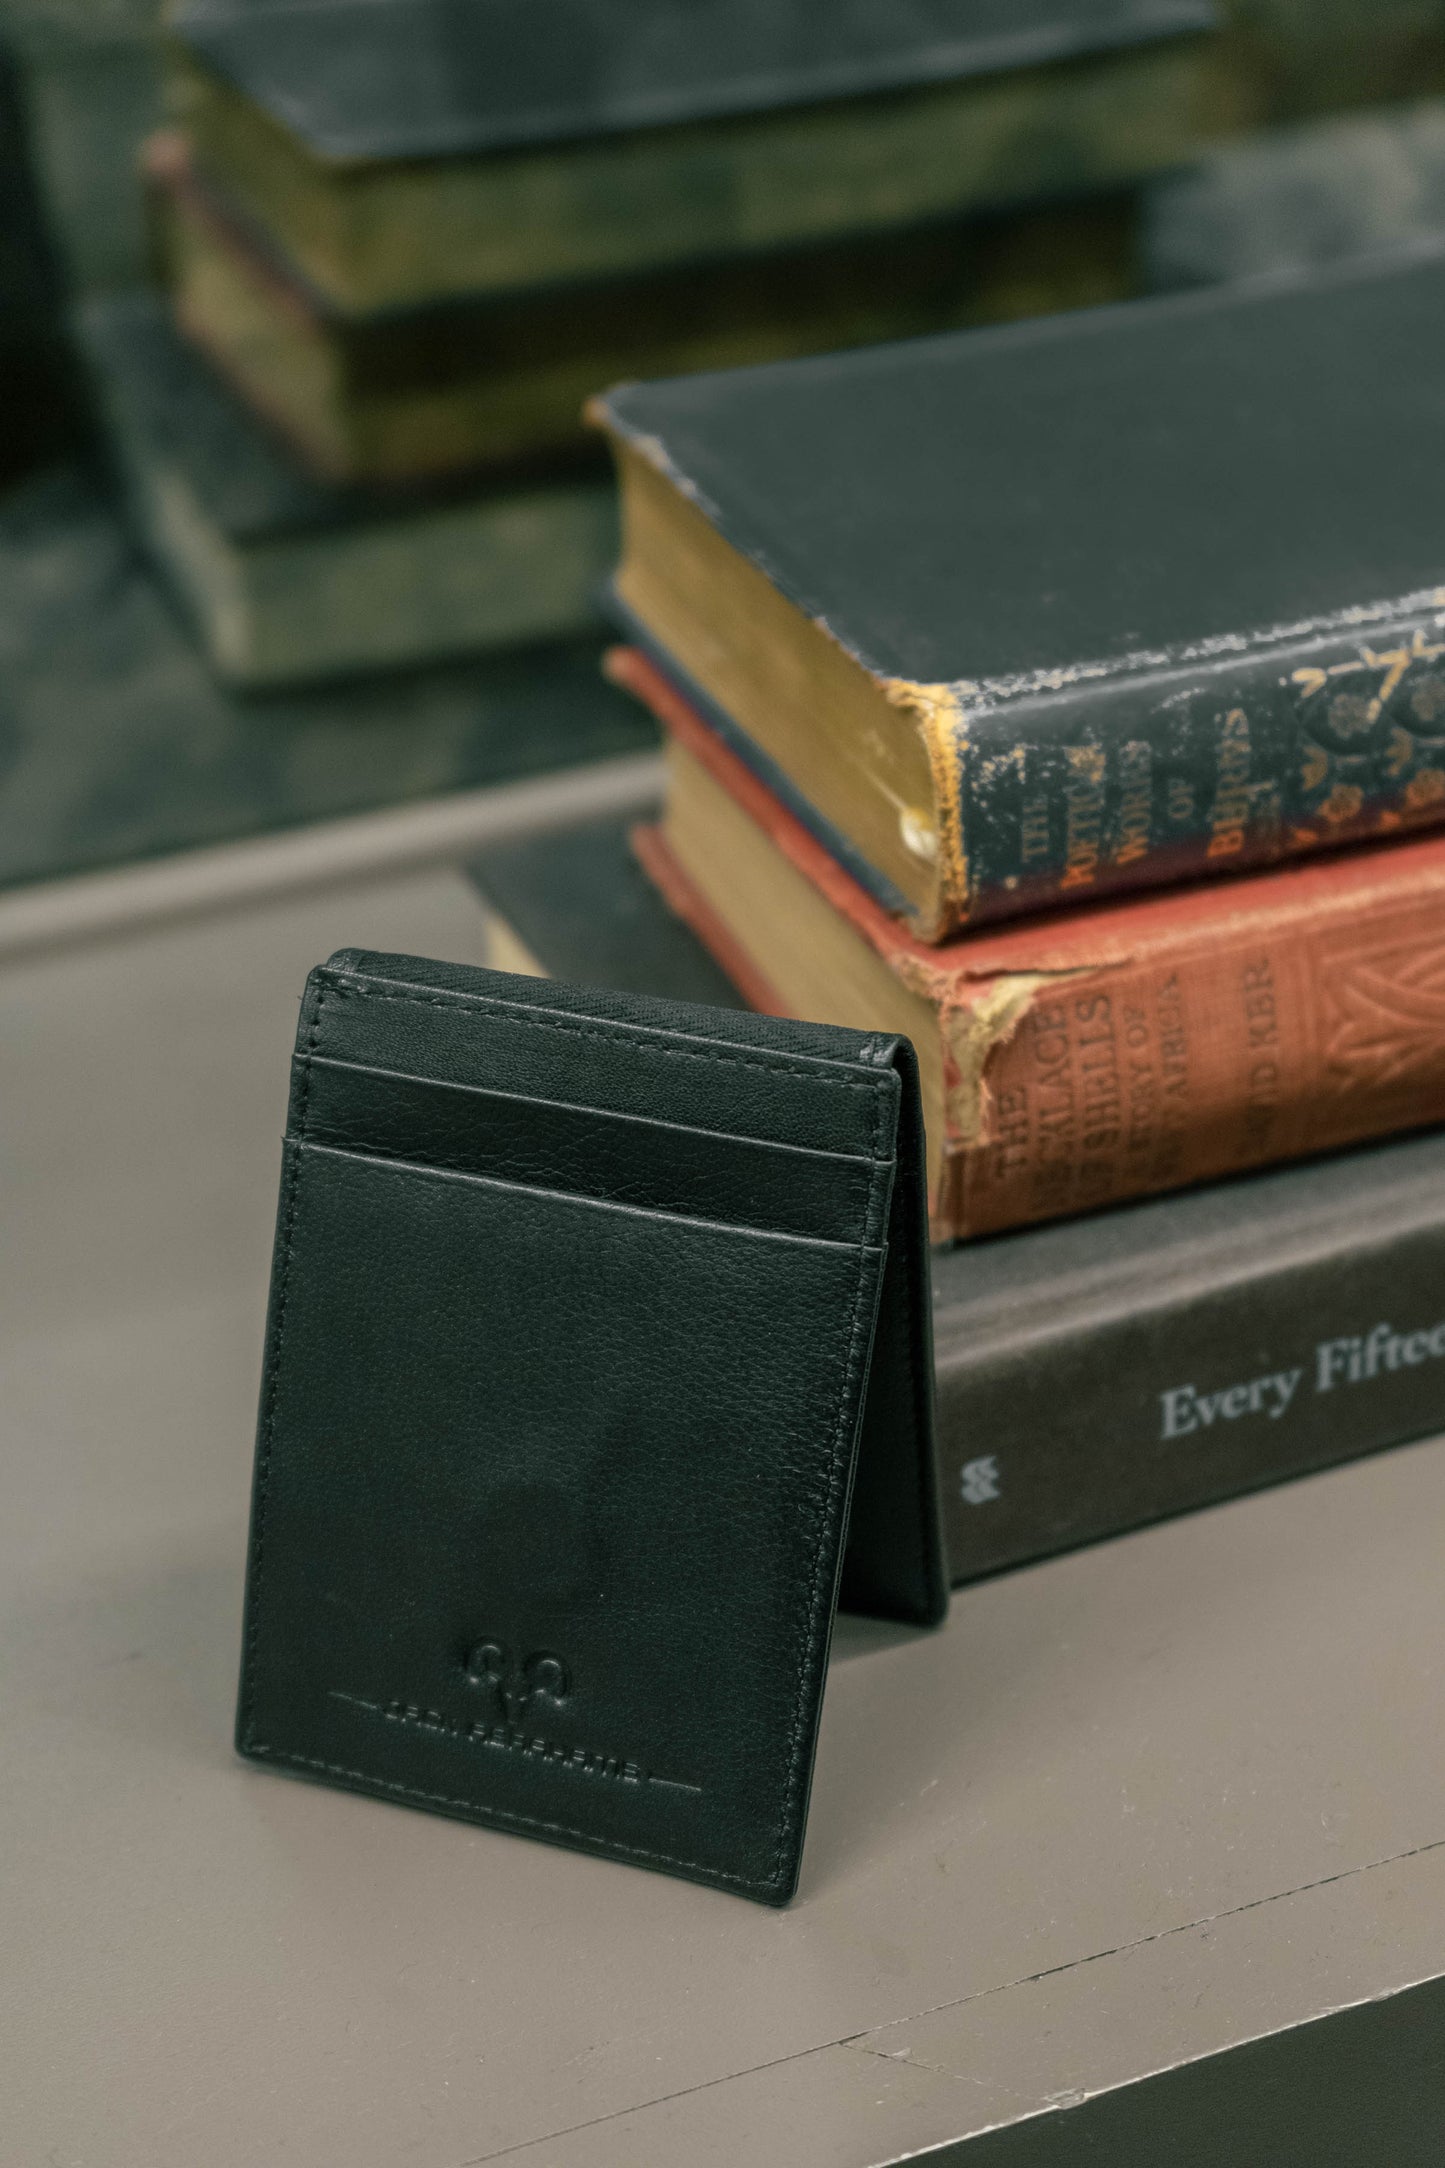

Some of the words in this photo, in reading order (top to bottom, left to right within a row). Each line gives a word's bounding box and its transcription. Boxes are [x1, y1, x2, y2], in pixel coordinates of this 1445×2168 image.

[1076, 991, 1122, 1151] SHELLS
[996, 1085, 1029, 1179] THE
[1160, 1367, 1301, 1440] Every
